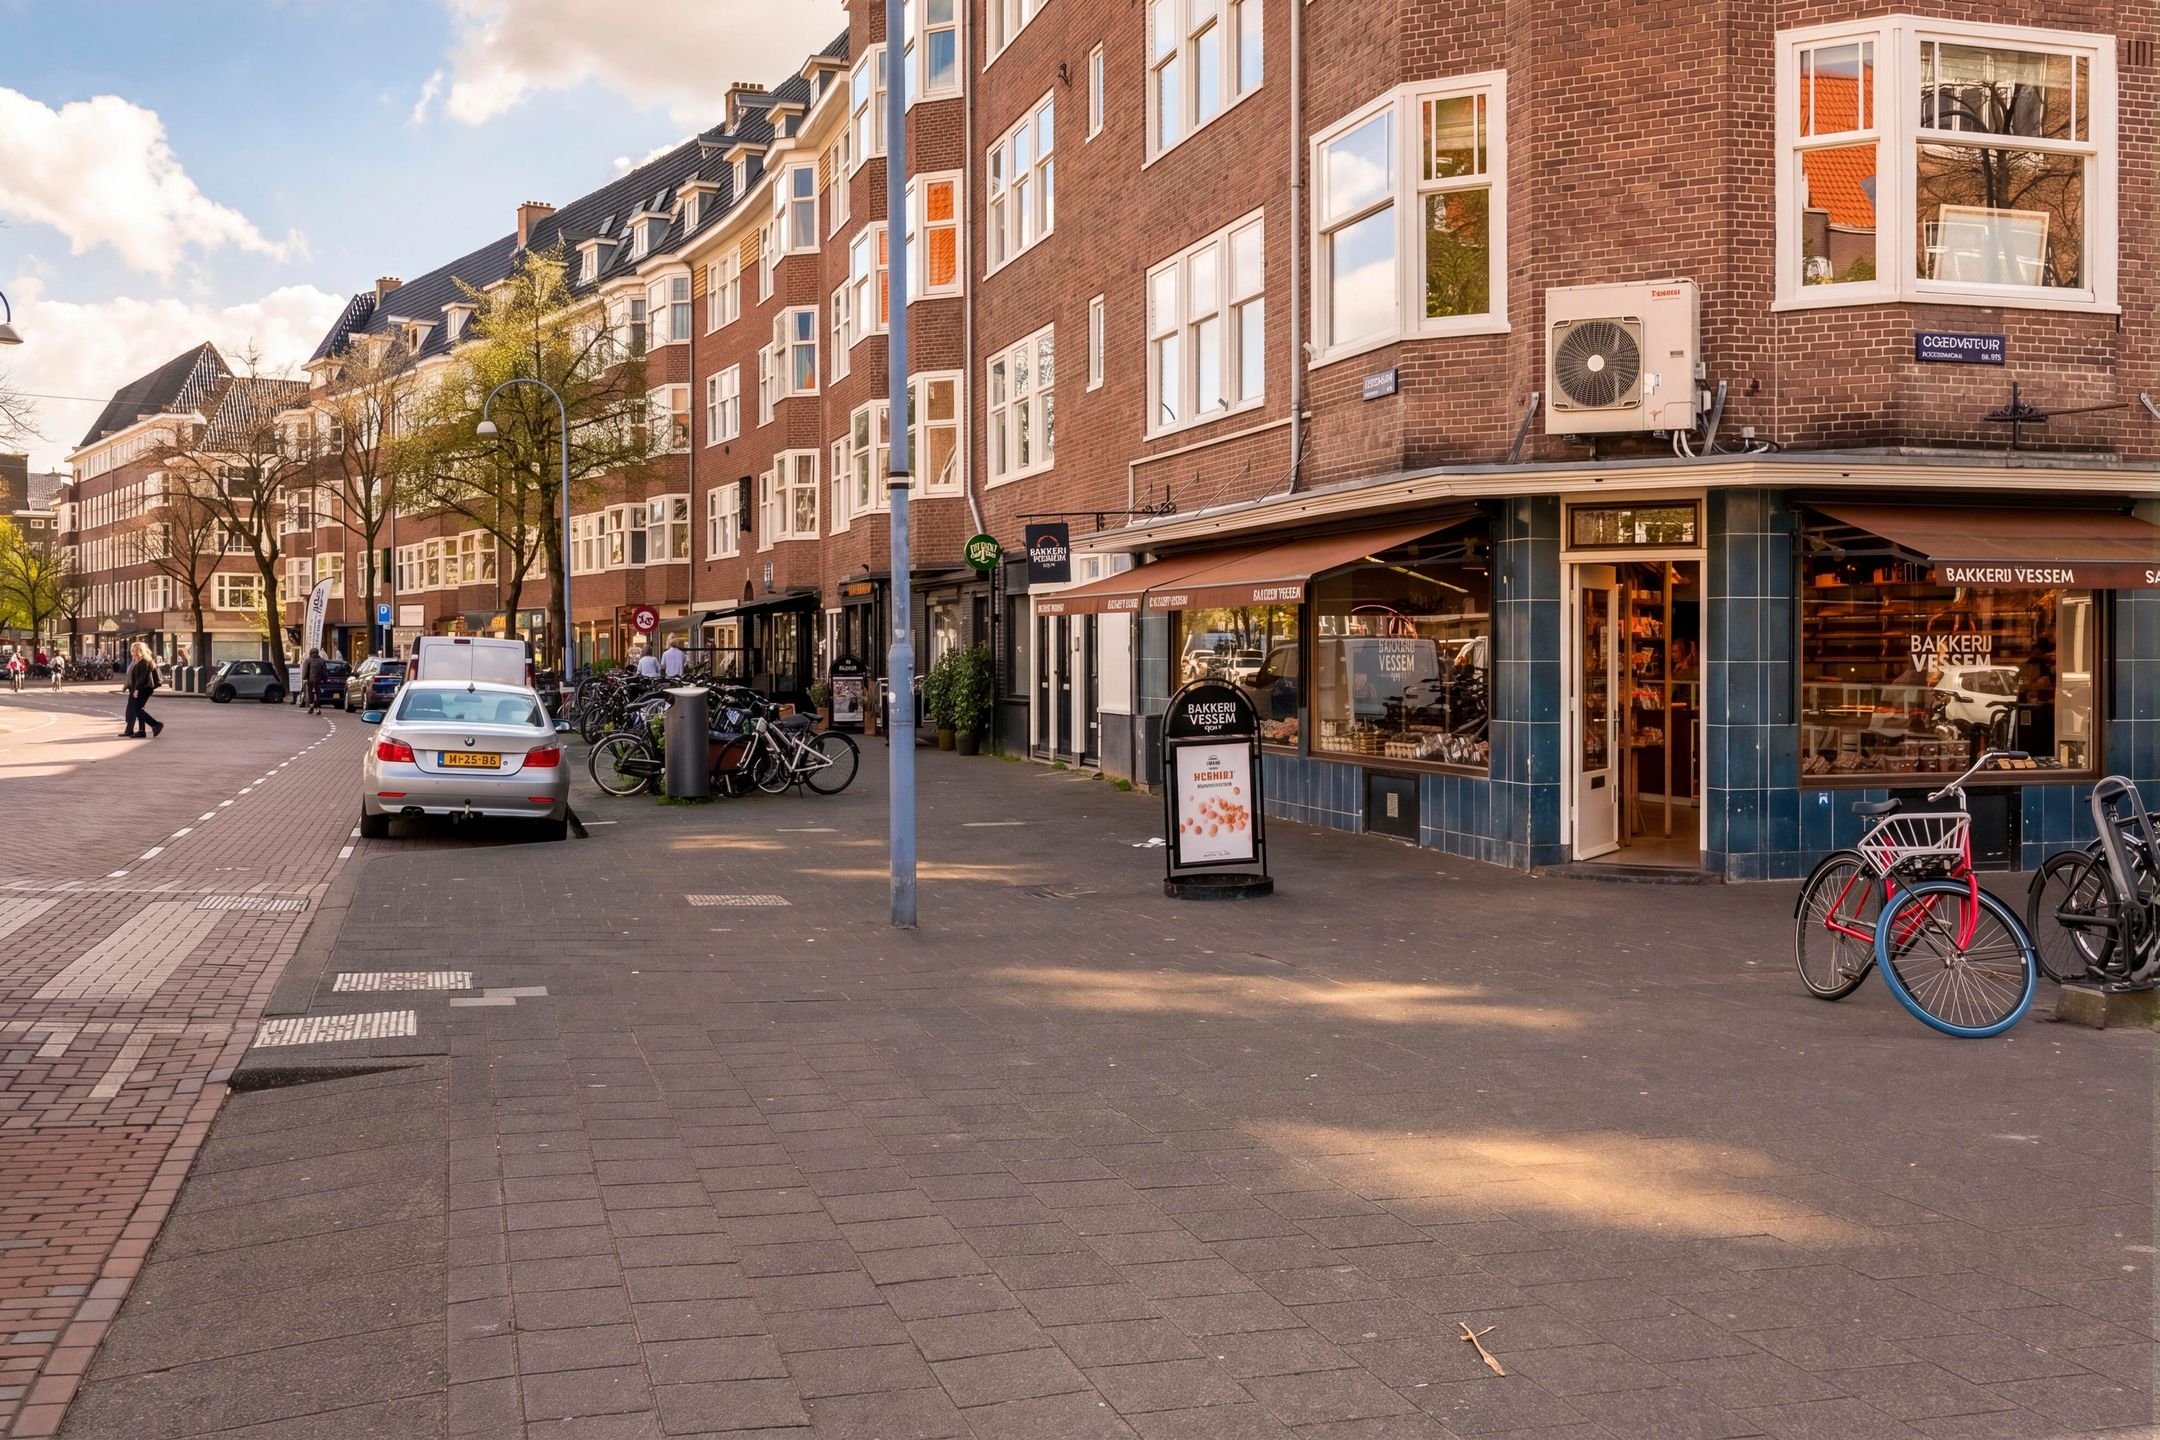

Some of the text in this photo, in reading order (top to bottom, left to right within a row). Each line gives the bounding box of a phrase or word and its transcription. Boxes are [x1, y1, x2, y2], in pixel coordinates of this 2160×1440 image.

[2015, 567, 2074, 583] VESSEM
[1378, 654, 1415, 672] VESSEM
[1189, 713, 1237, 726] VESSEM
